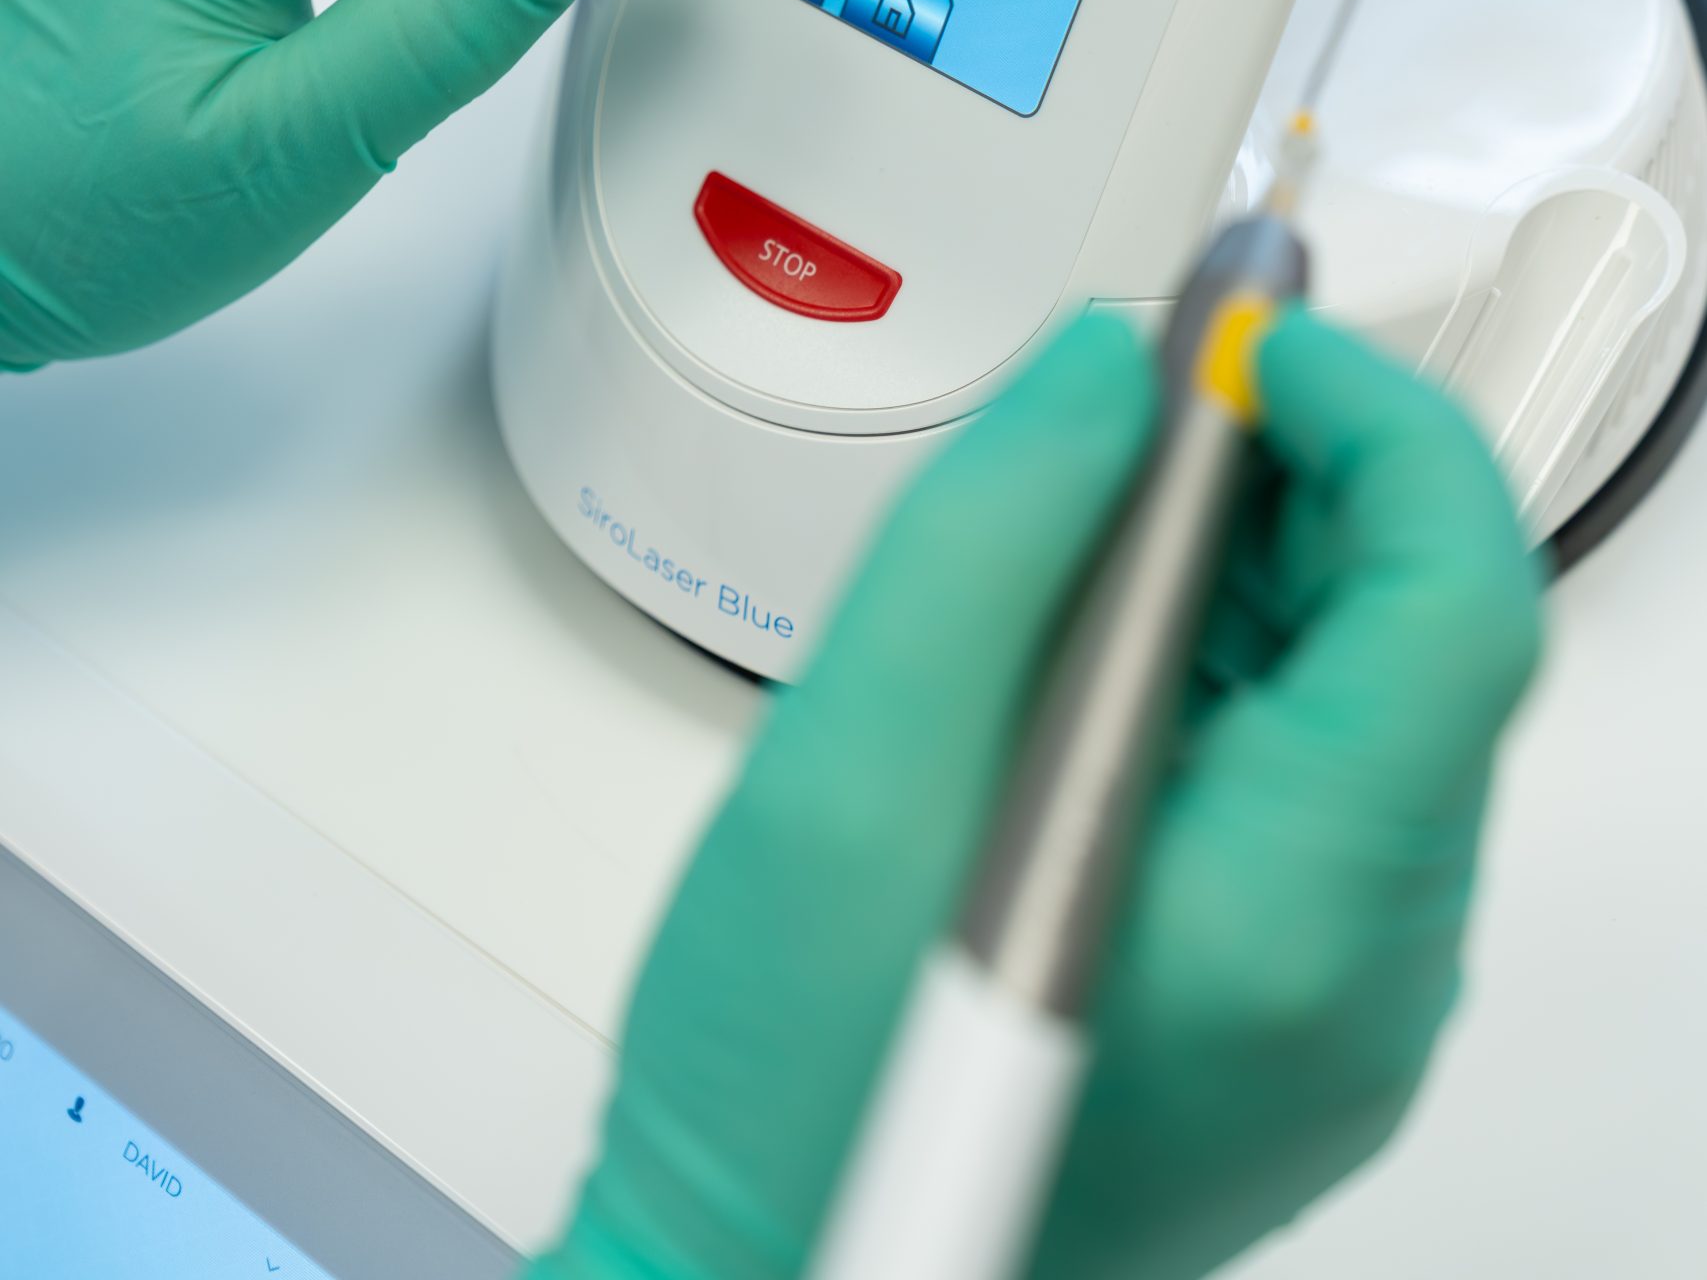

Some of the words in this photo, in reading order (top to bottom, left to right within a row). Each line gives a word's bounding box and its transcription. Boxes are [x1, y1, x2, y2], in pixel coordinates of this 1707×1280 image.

[758, 239, 817, 281] STOP
[577, 486, 707, 598] SiroLaser
[718, 584, 794, 639] Blue
[122, 1140, 182, 1198] DAVID
